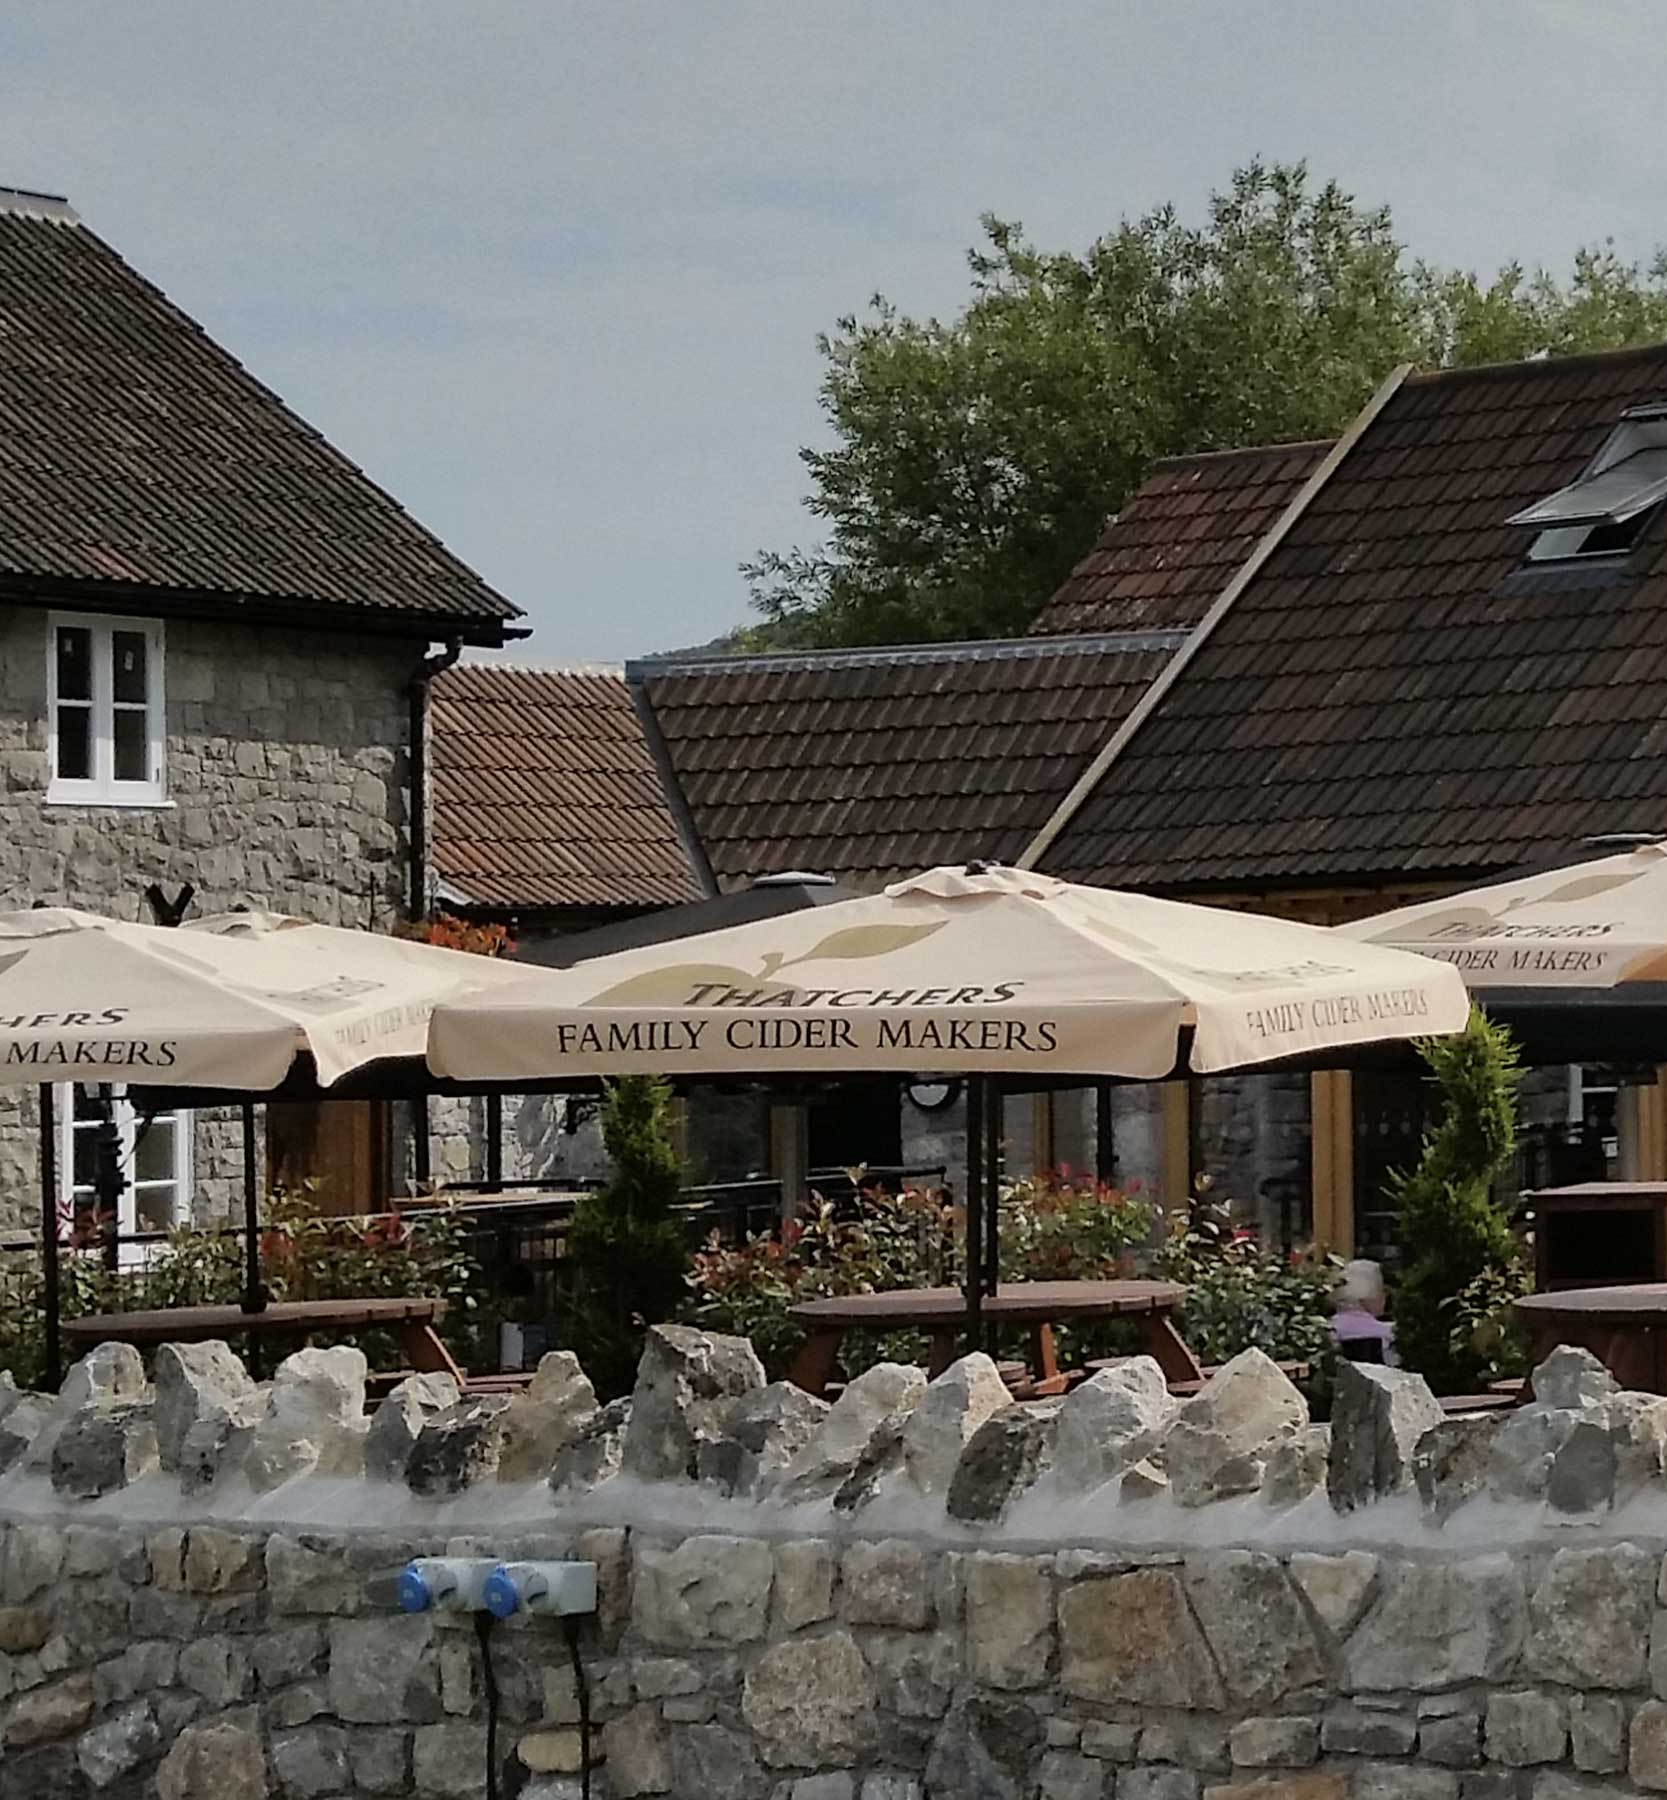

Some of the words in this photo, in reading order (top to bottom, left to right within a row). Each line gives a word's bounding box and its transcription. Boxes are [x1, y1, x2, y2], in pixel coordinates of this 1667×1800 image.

[1505, 950, 1608, 971] MAKERS
[682, 981, 1025, 1007] THATCHERS
[1311, 995, 1363, 1028] CIDER
[556, 1020, 710, 1054] FAMILY
[725, 1017, 860, 1050] CIDER
[875, 1018, 1058, 1052] MAKERS
[6, 1040, 178, 1067] MAKERS
